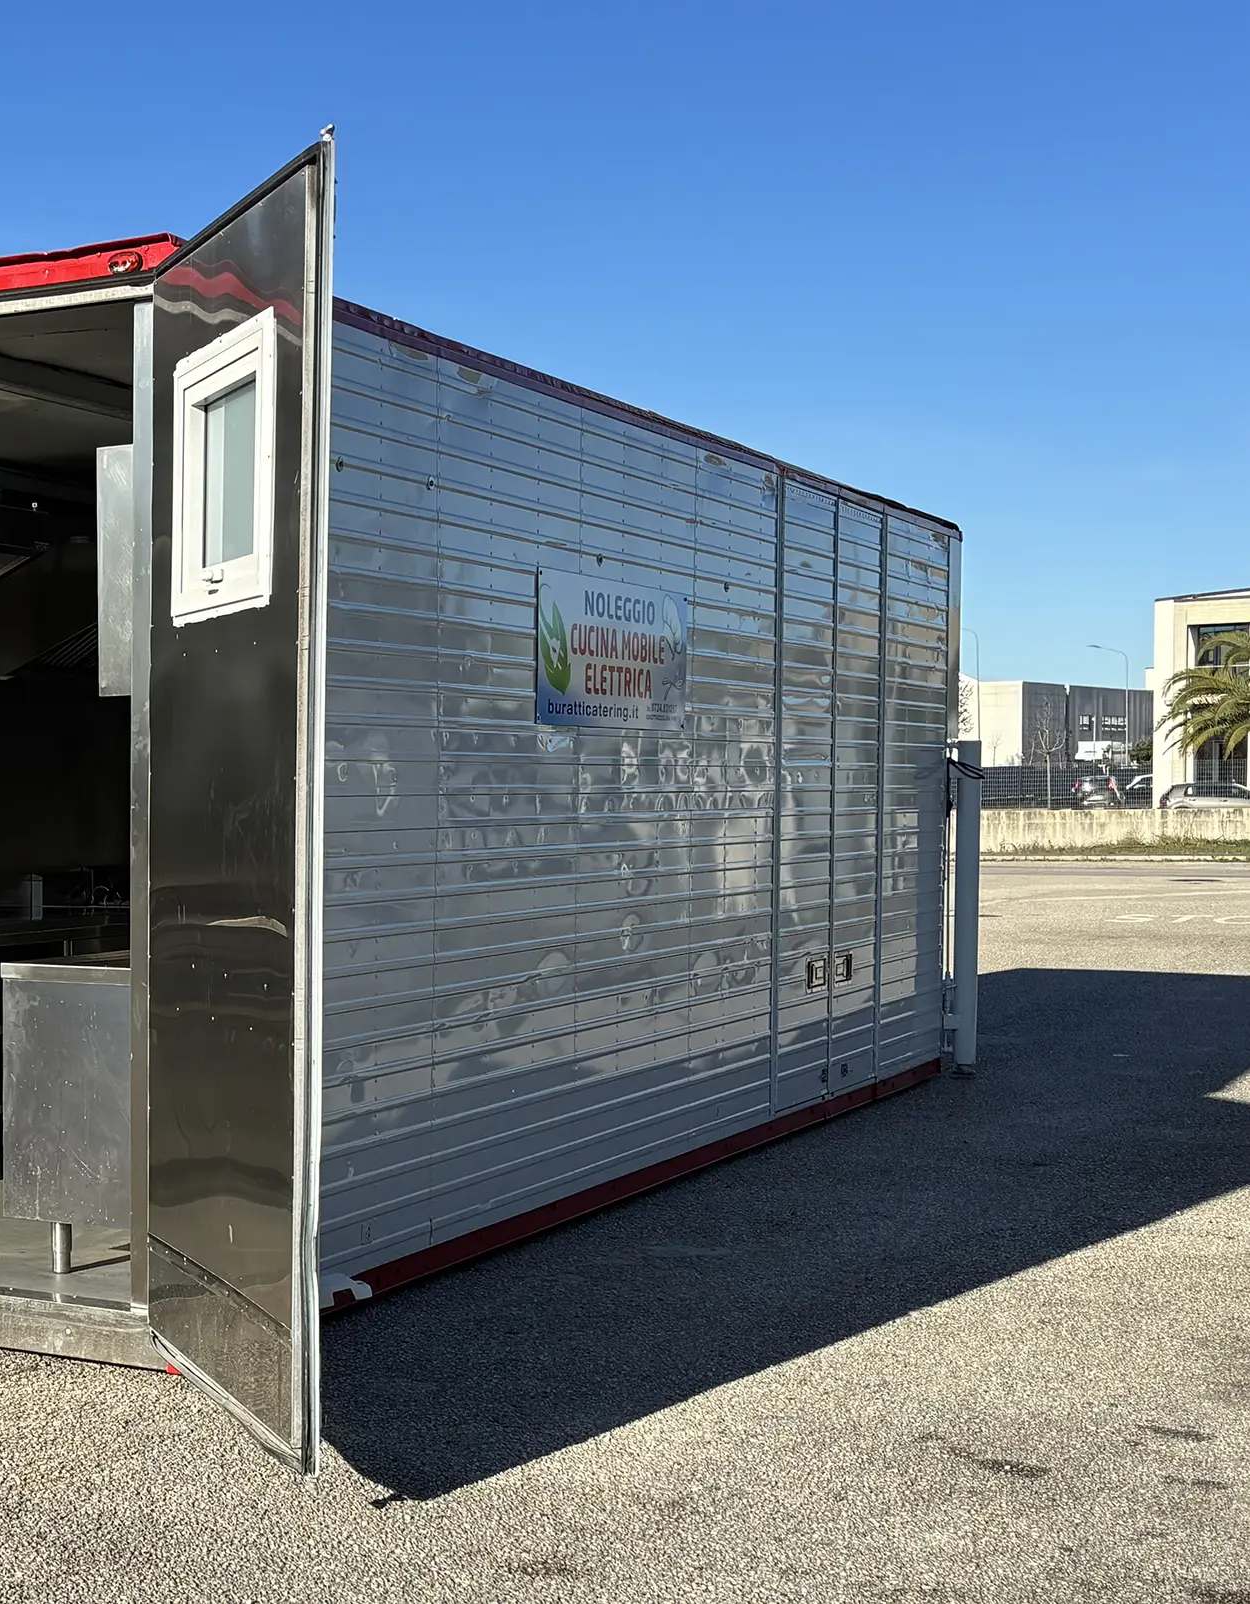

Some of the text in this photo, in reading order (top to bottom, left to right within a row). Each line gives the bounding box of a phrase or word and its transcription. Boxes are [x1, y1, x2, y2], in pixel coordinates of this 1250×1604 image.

[584, 590, 656, 626] NOLEGGIO
[570, 622, 665, 665] CUCINA MOBILE
[585, 663, 652, 699] ELETTRICA
[547, 699, 639, 721] buratticatering.it
